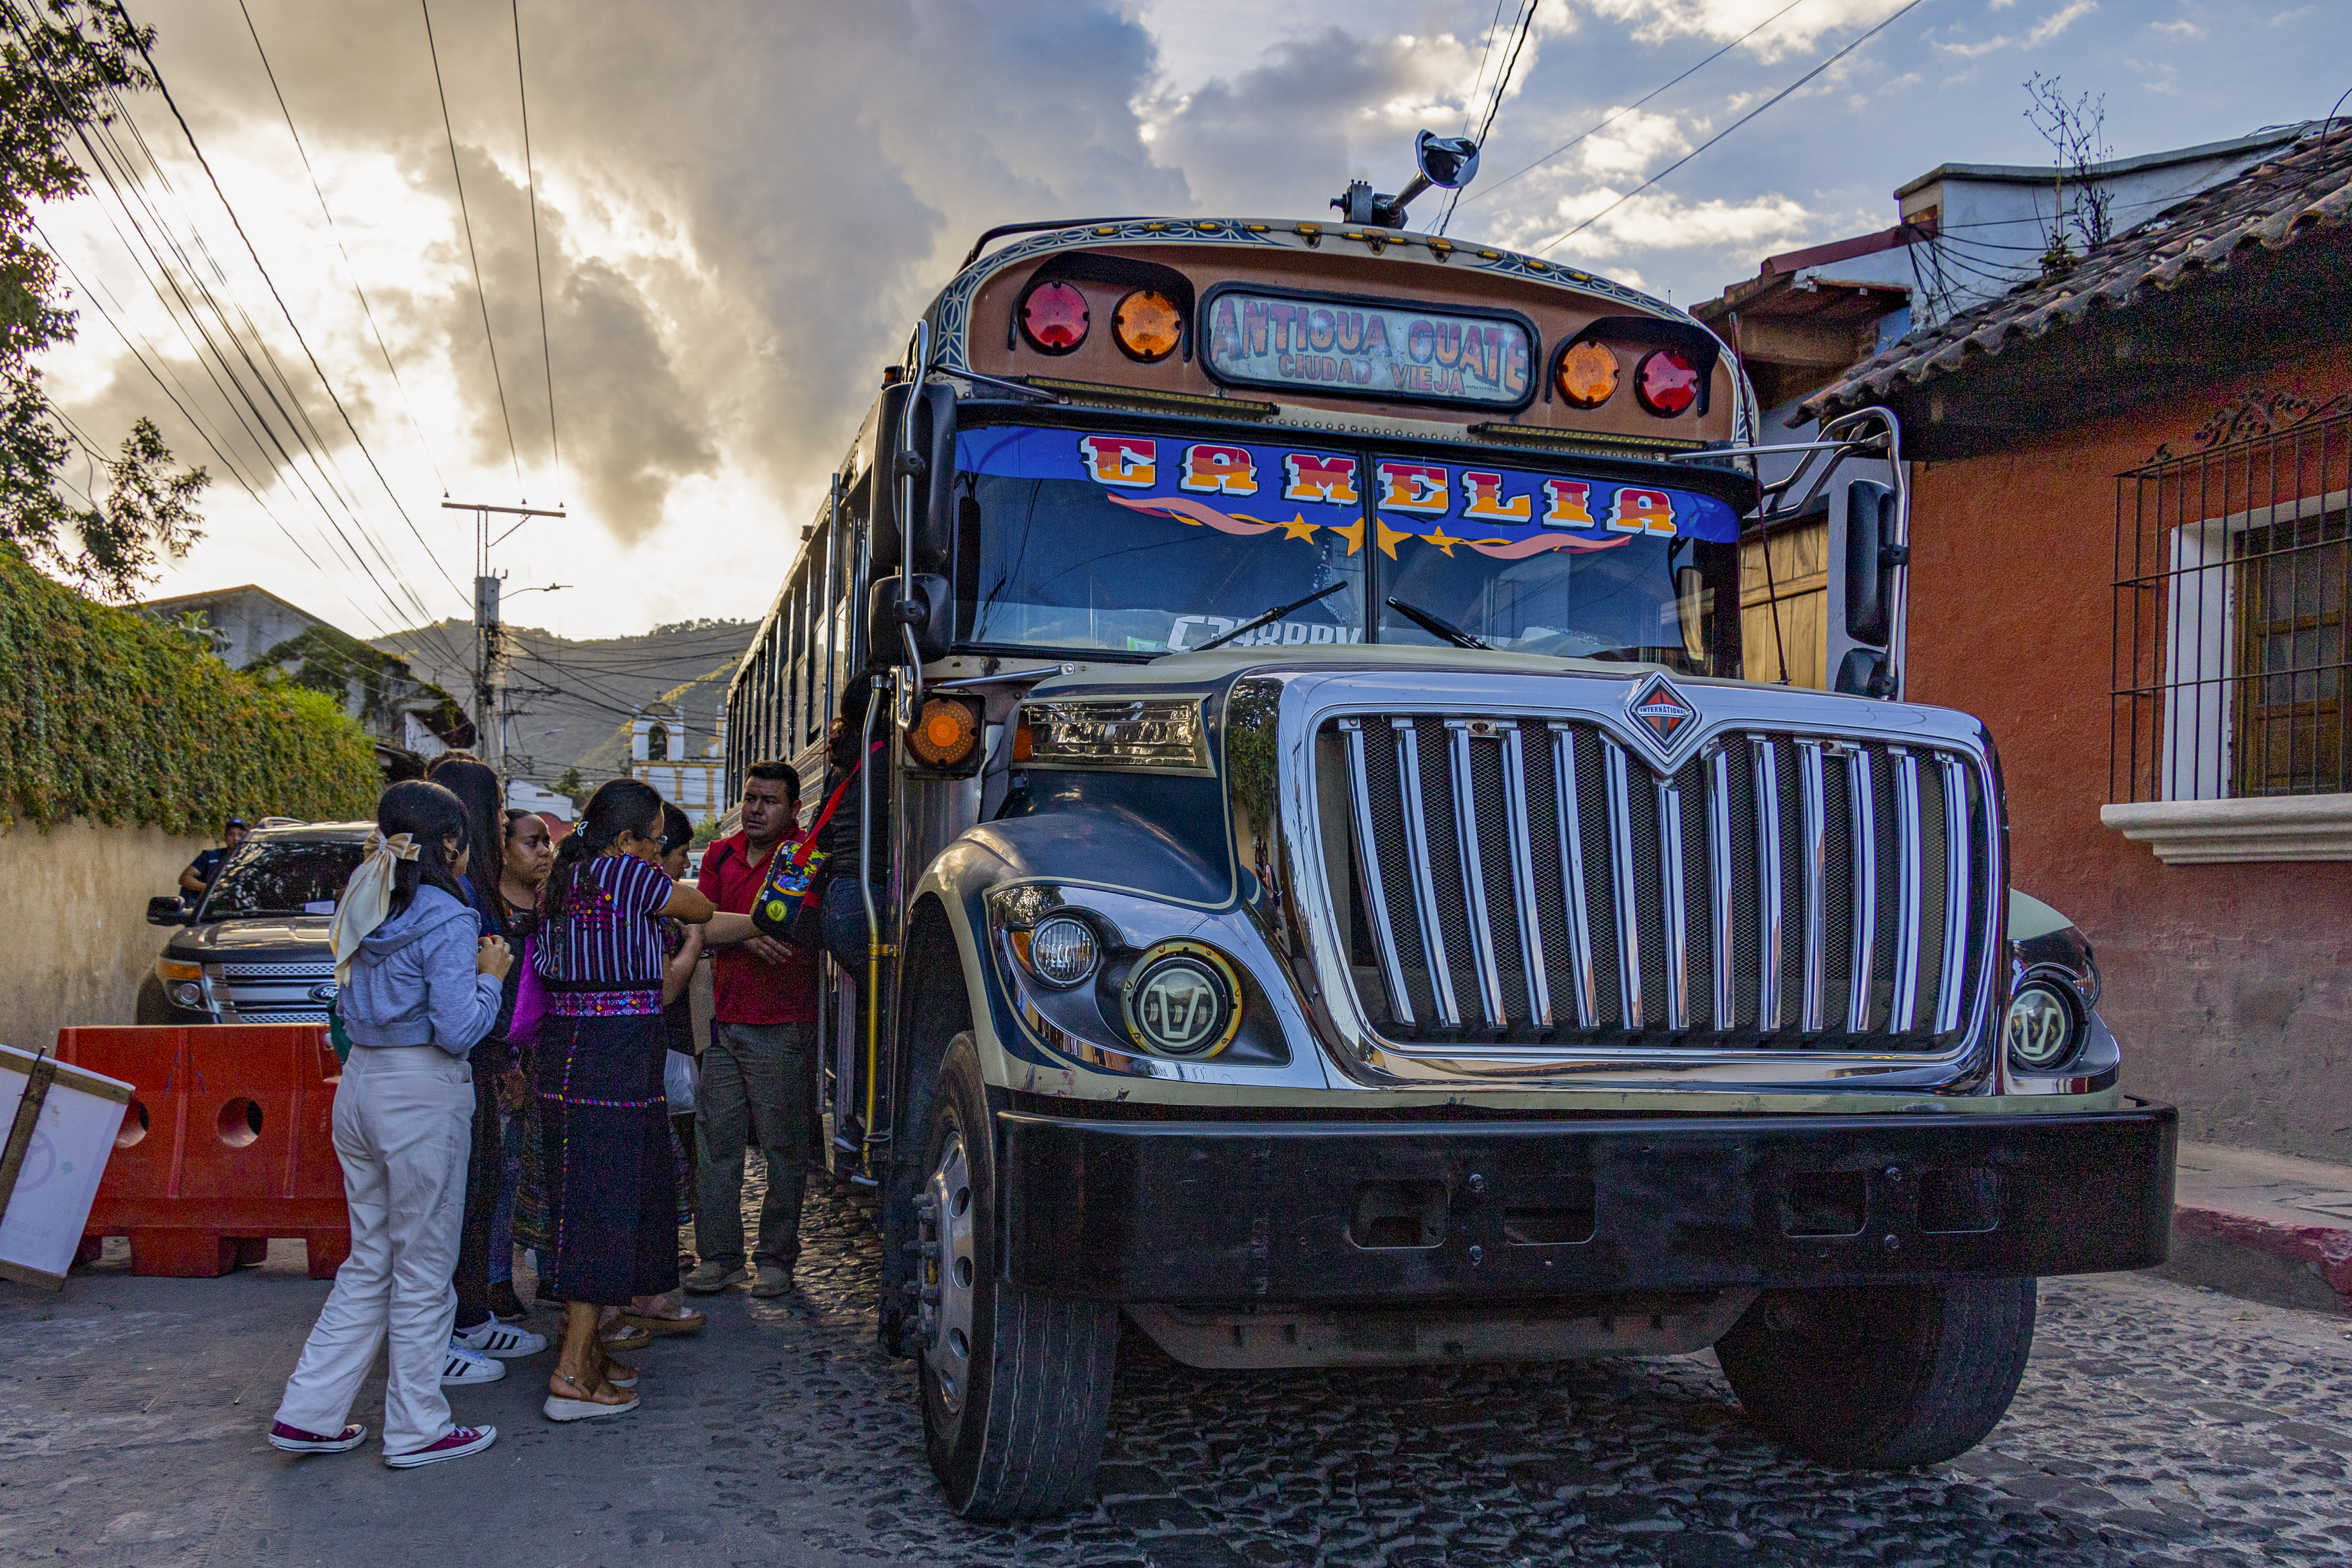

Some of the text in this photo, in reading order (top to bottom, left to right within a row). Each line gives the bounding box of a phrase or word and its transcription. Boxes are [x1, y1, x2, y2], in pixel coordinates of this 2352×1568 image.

[1211, 300, 1527, 397] ANTIGUA GUATE
[1279, 353, 1465, 395] CIUDAD VIEJA
[1080, 435, 1677, 538] CAMELIA
[1640, 706, 1687, 715] INTERNATIONAL
[320, 986, 338, 998] Fo
